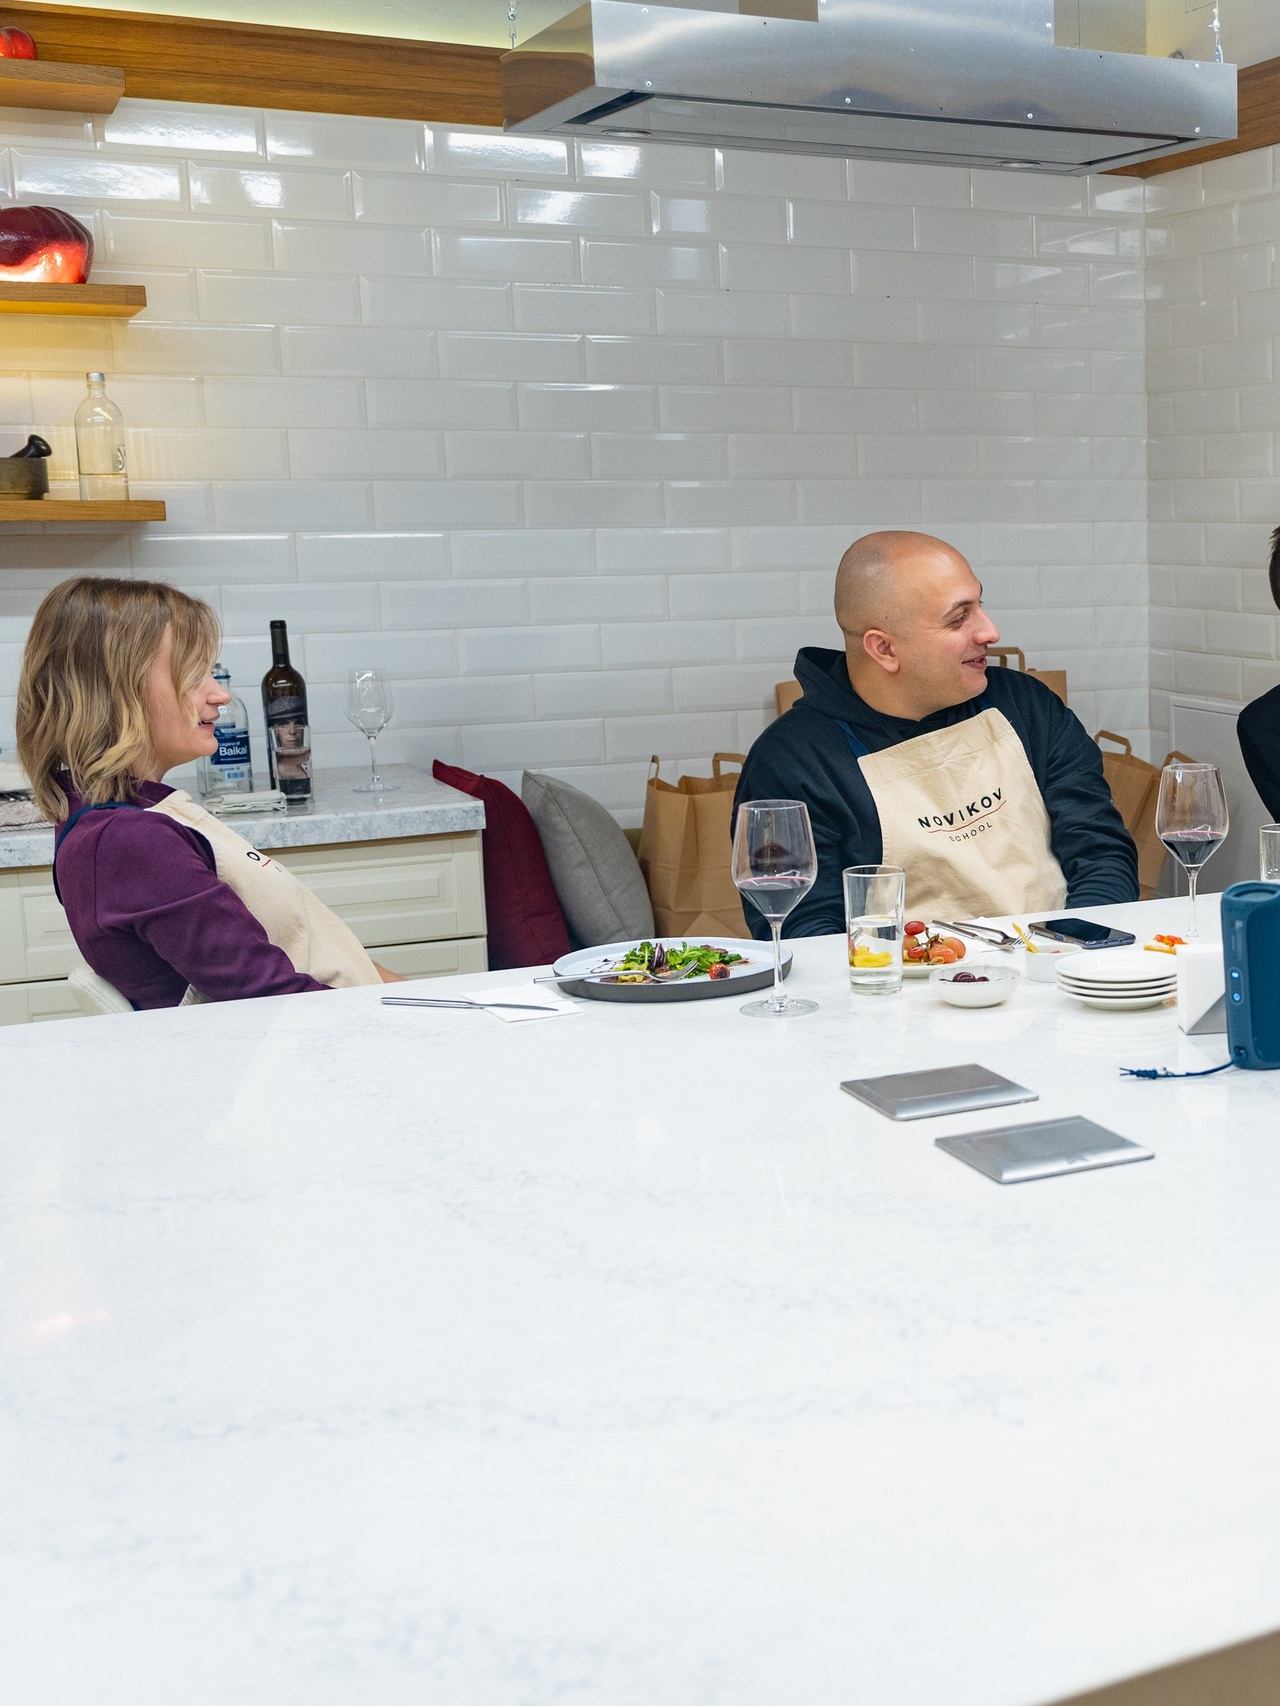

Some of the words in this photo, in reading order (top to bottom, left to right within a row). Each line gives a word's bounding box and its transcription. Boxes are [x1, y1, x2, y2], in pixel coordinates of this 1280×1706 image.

[219, 745, 248, 756] Baikal
[917, 787, 1003, 829] NOVIKOV
[949, 821, 993, 842] SCHOOL
